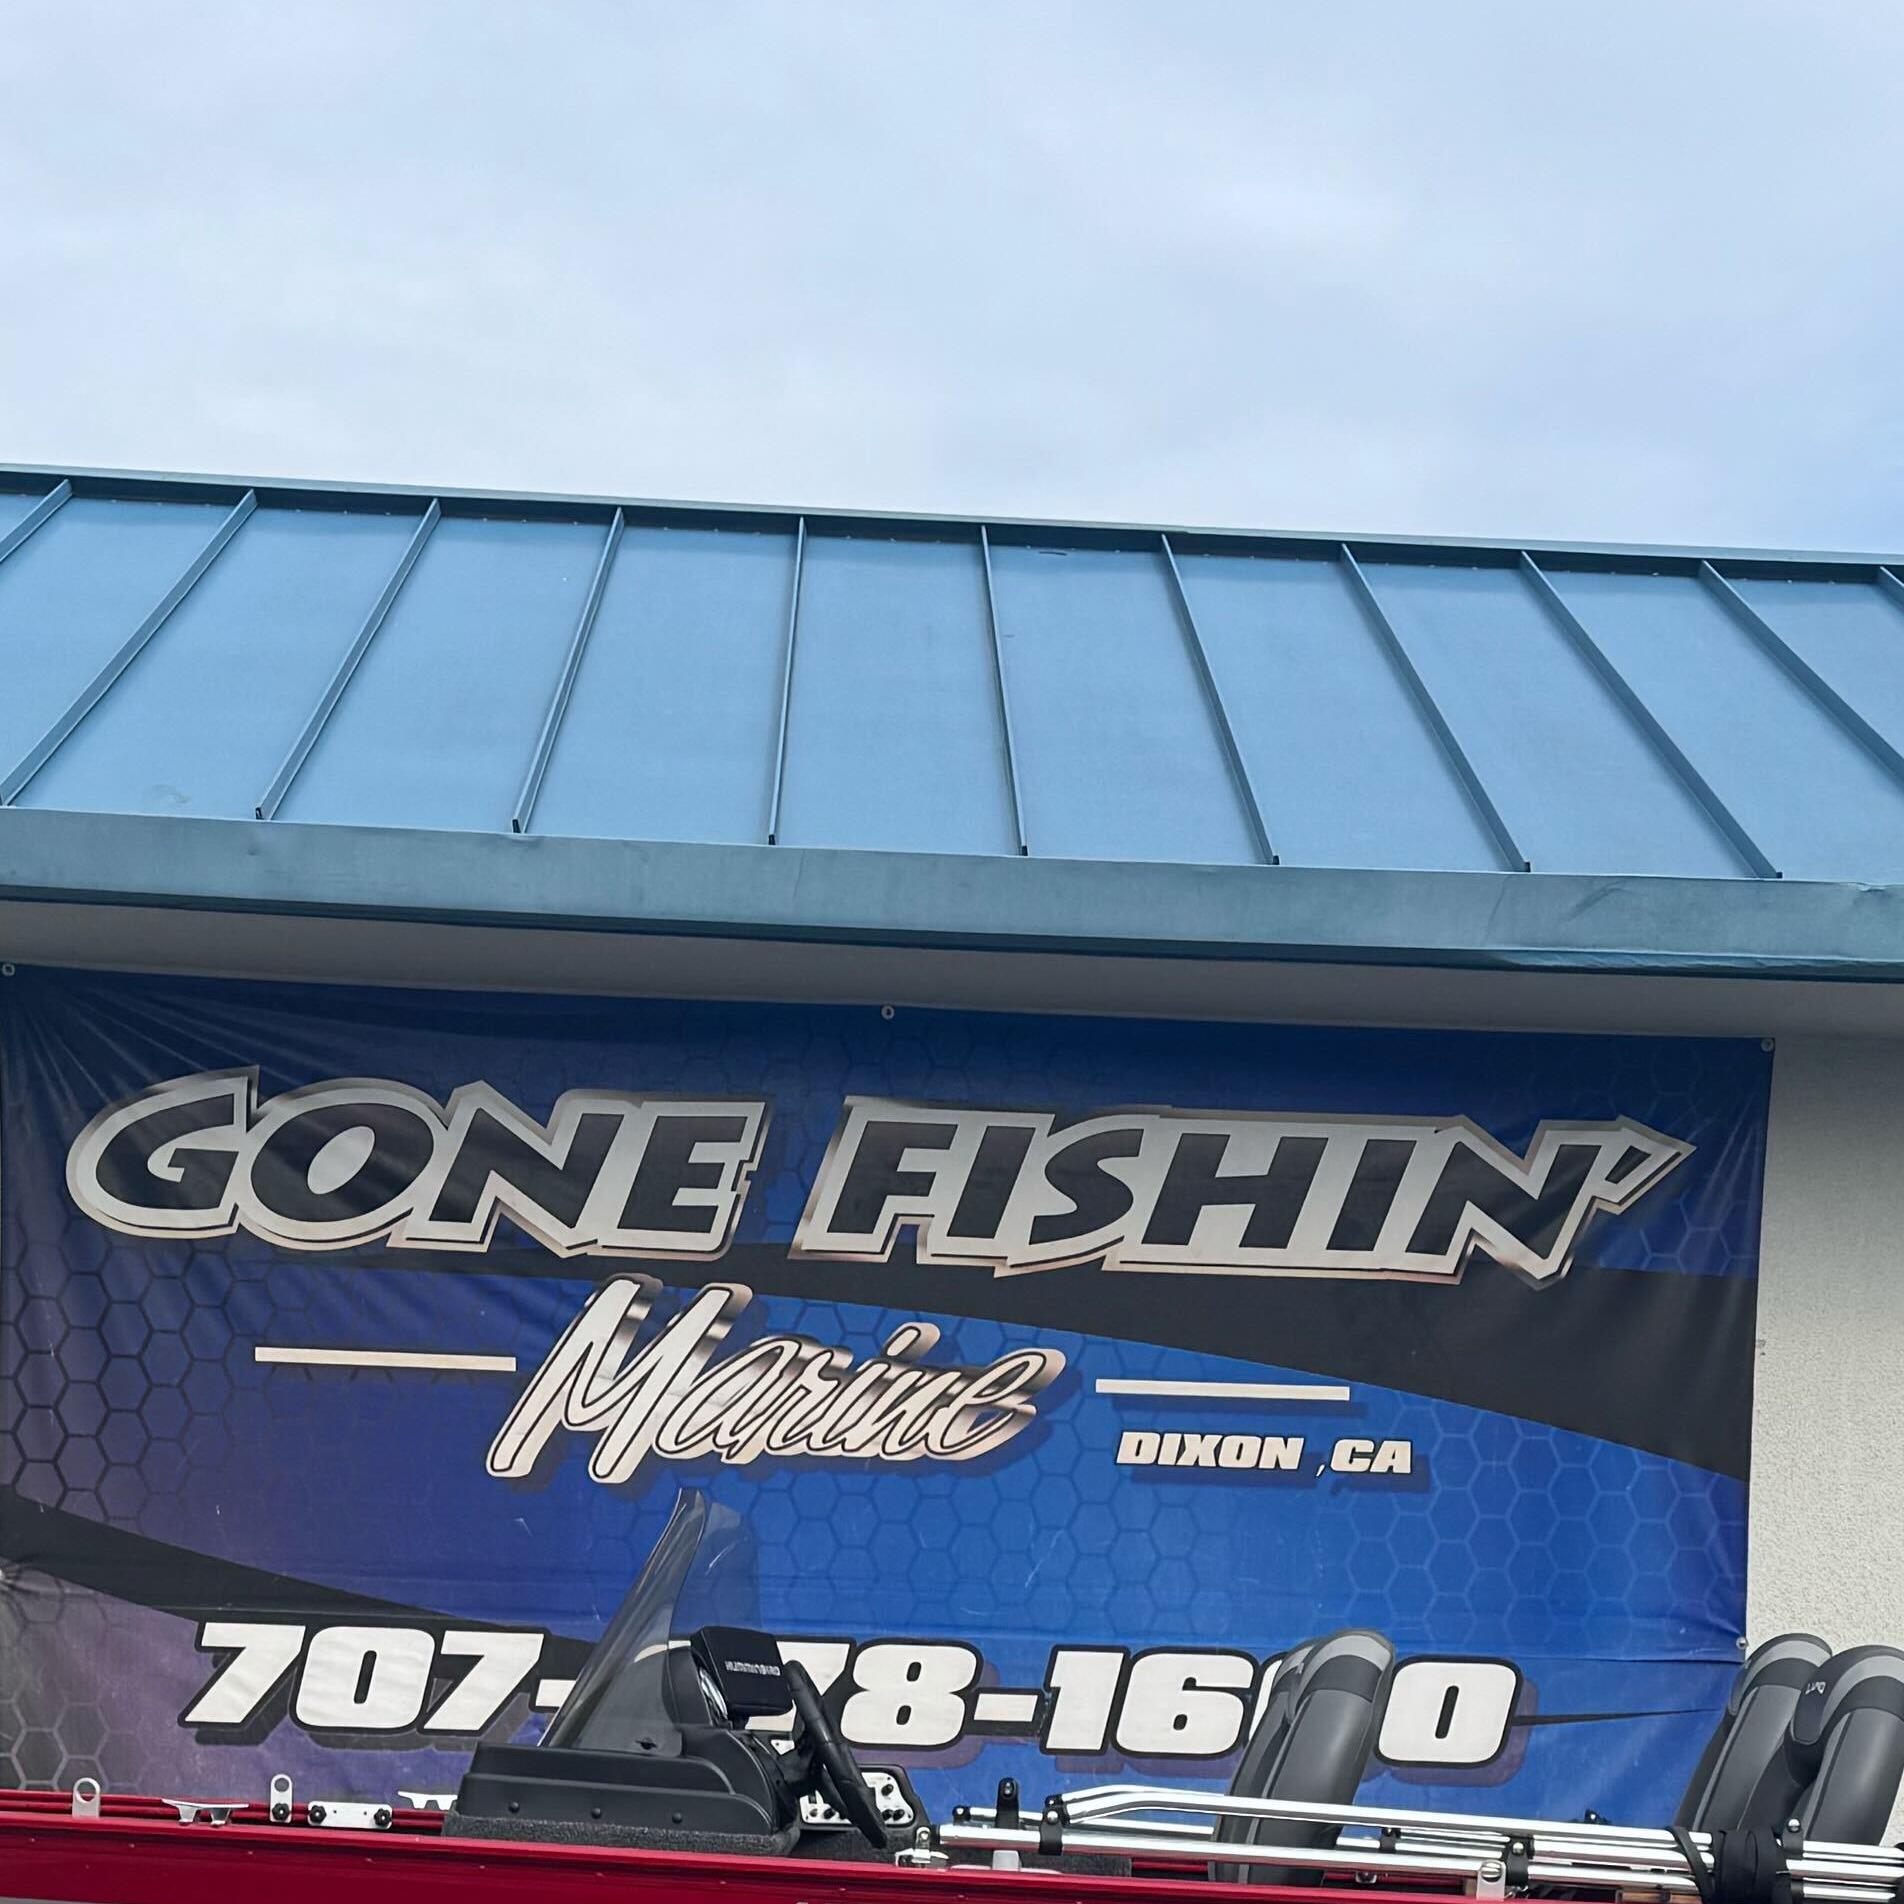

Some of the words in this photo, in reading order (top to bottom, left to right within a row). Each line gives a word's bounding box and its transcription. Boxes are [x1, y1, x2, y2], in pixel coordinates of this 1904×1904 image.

[72, 1070, 762, 1252] GONE
[796, 1100, 1692, 1284] FISHIN'
[487, 1273, 1066, 1484] Marine
[1115, 1431, 1305, 1470] DIXON
